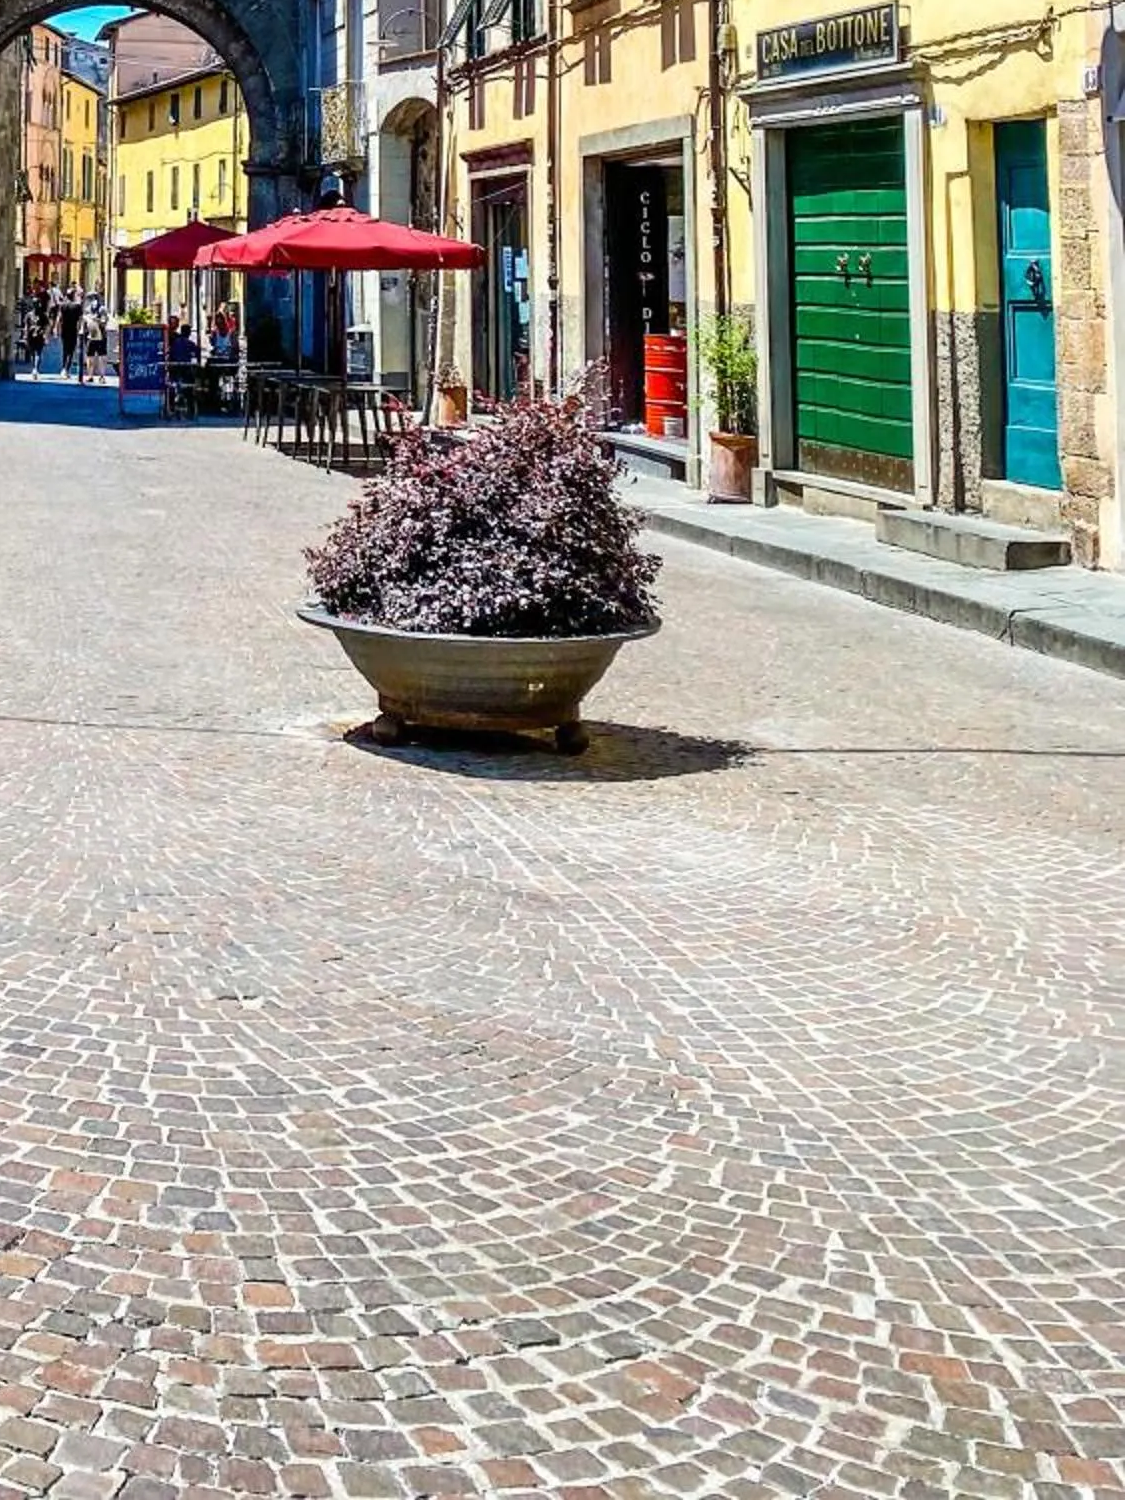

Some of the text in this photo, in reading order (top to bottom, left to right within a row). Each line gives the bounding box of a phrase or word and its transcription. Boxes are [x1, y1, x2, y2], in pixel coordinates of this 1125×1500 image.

[762, 29, 798, 63] CASA
[816, 8, 890, 53] BOTTONE
[640, 191, 652, 263] CICLO
